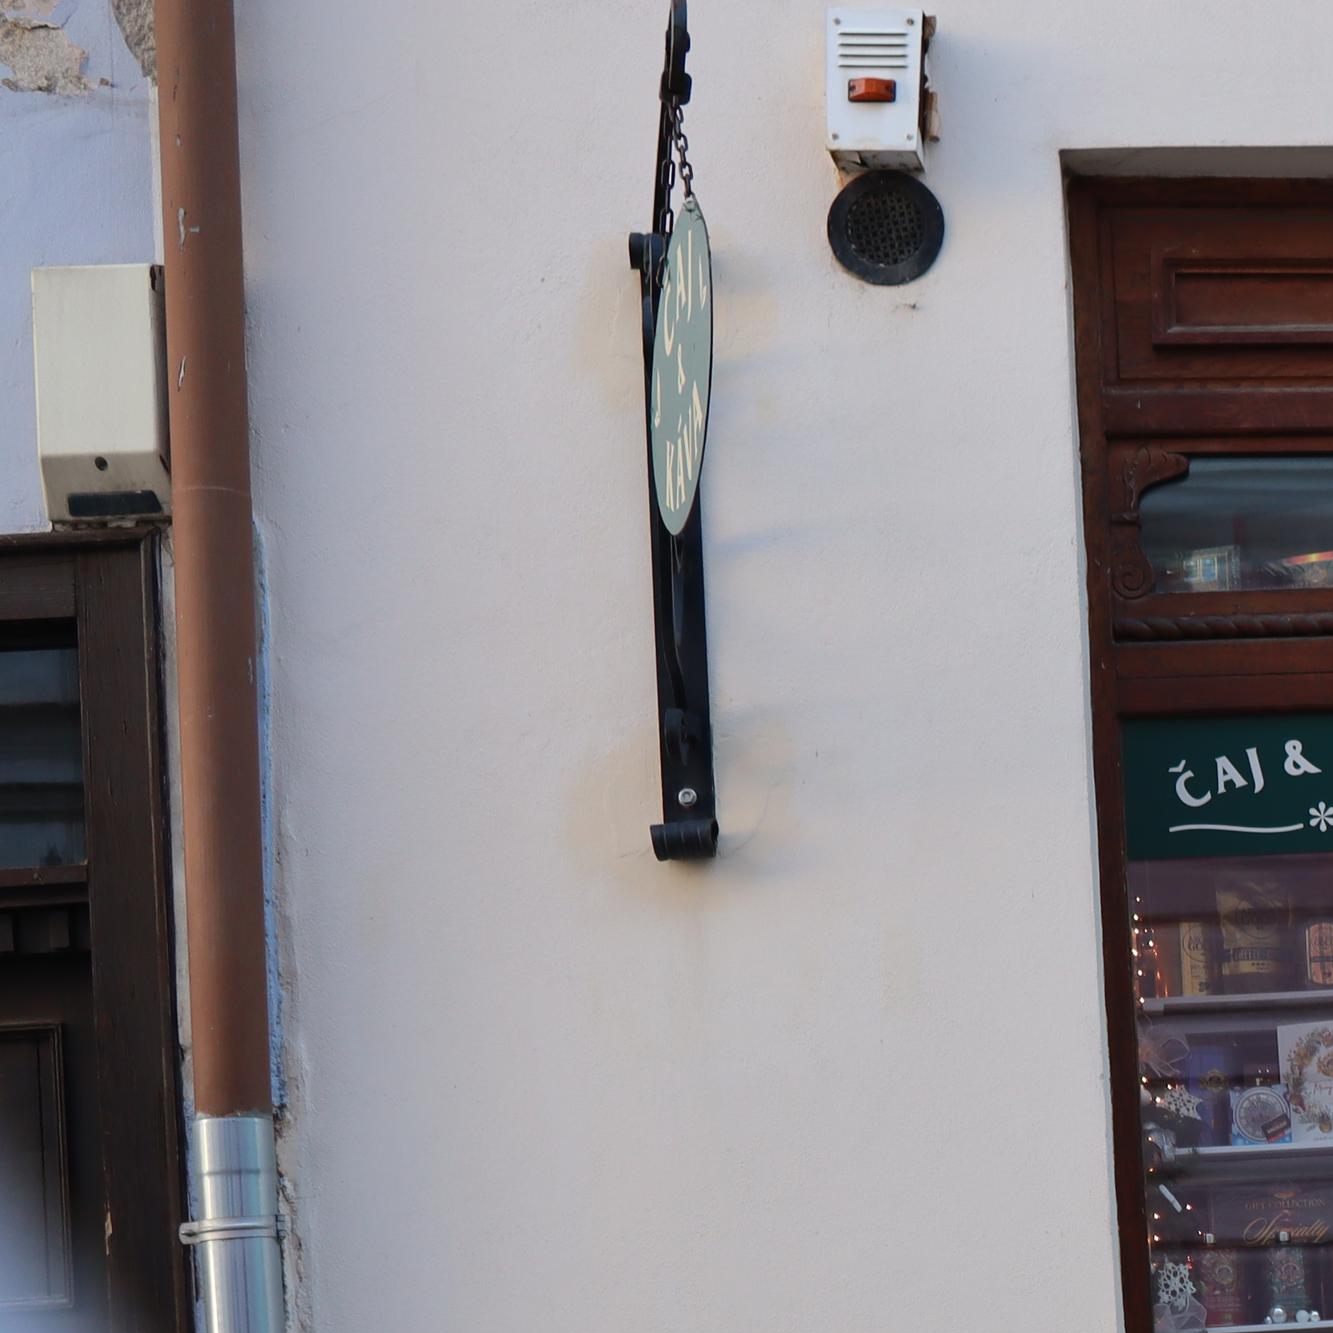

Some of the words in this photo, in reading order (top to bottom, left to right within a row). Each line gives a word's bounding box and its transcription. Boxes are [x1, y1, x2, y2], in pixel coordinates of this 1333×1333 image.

[665, 380, 704, 513] KÁVA
[1168, 747, 1266, 808] ČAJ
[1283, 739, 1322, 776] &
